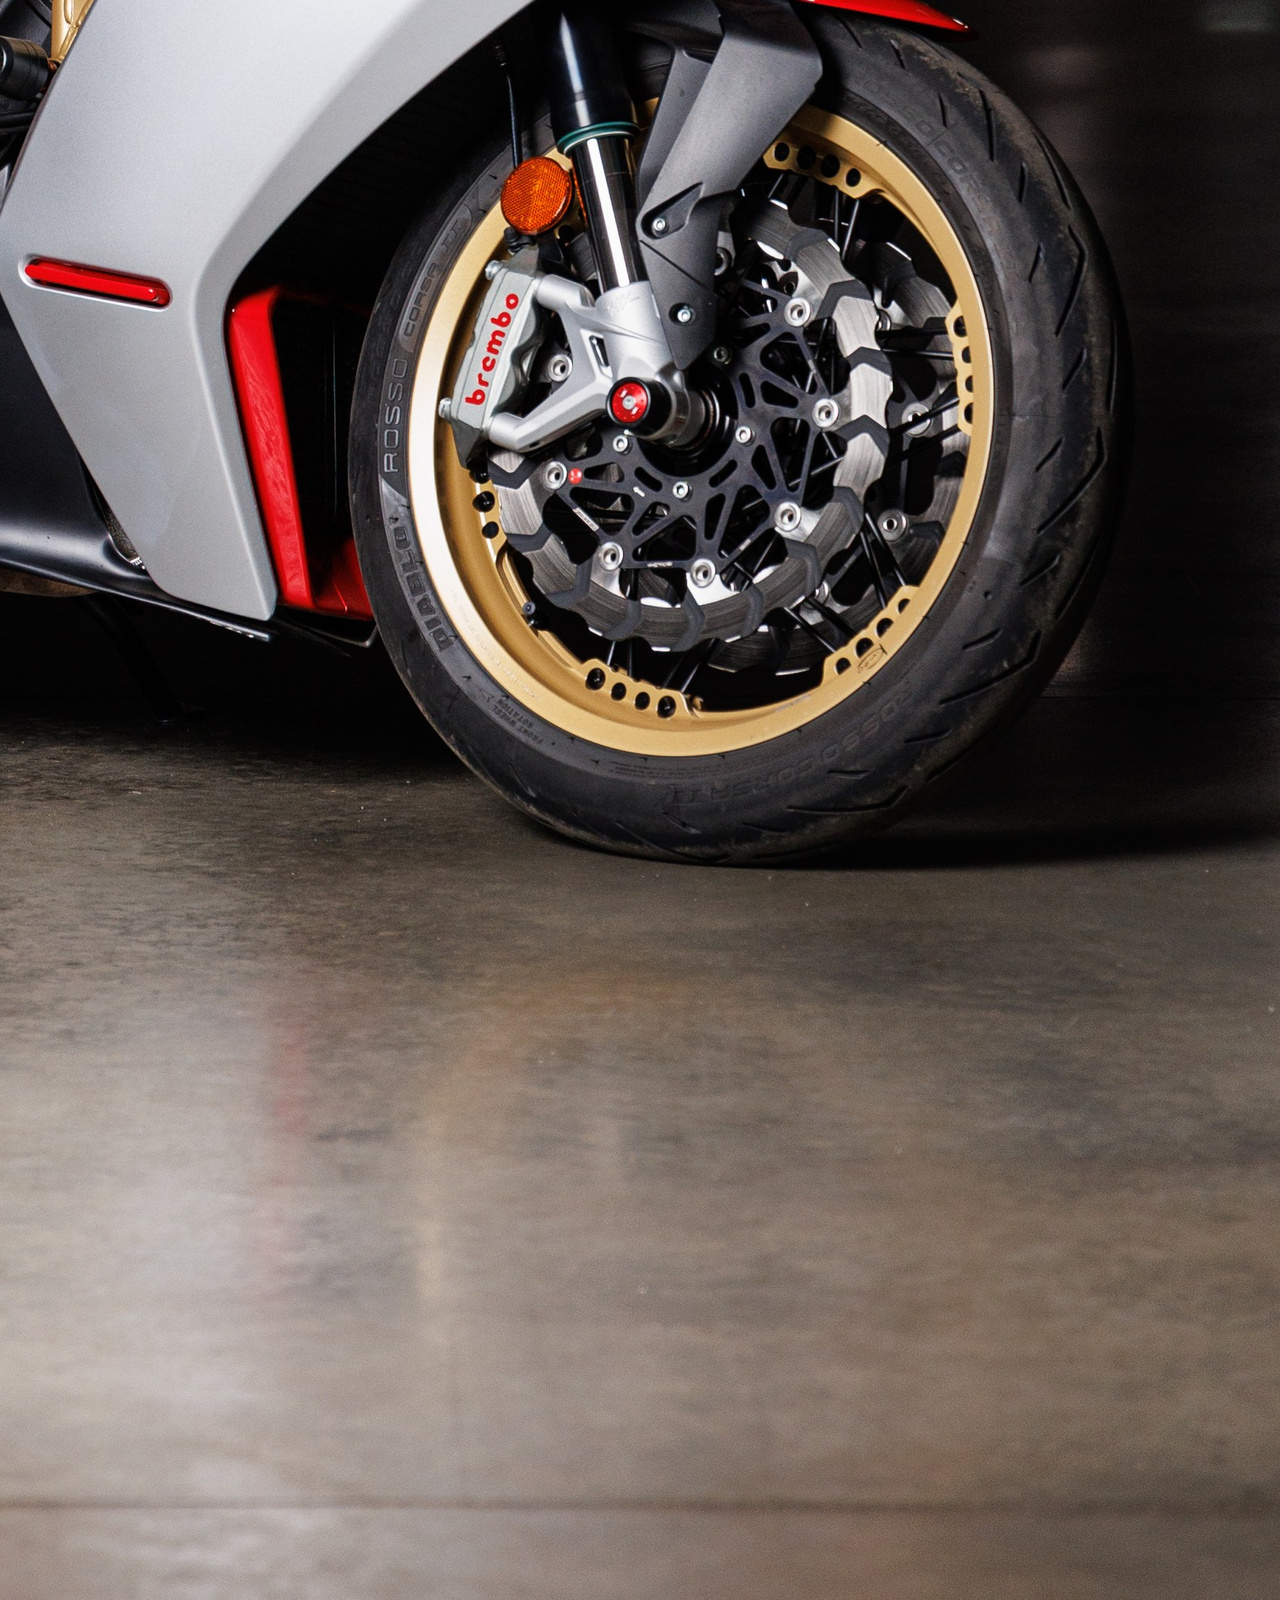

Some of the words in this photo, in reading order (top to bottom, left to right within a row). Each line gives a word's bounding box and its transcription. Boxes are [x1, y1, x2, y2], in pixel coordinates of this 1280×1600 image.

[403, 260, 439, 337] CORSA
[465, 293, 519, 407] brembo
[382, 356, 409, 475] ROSSO
[391, 523, 453, 655] DIABLO
